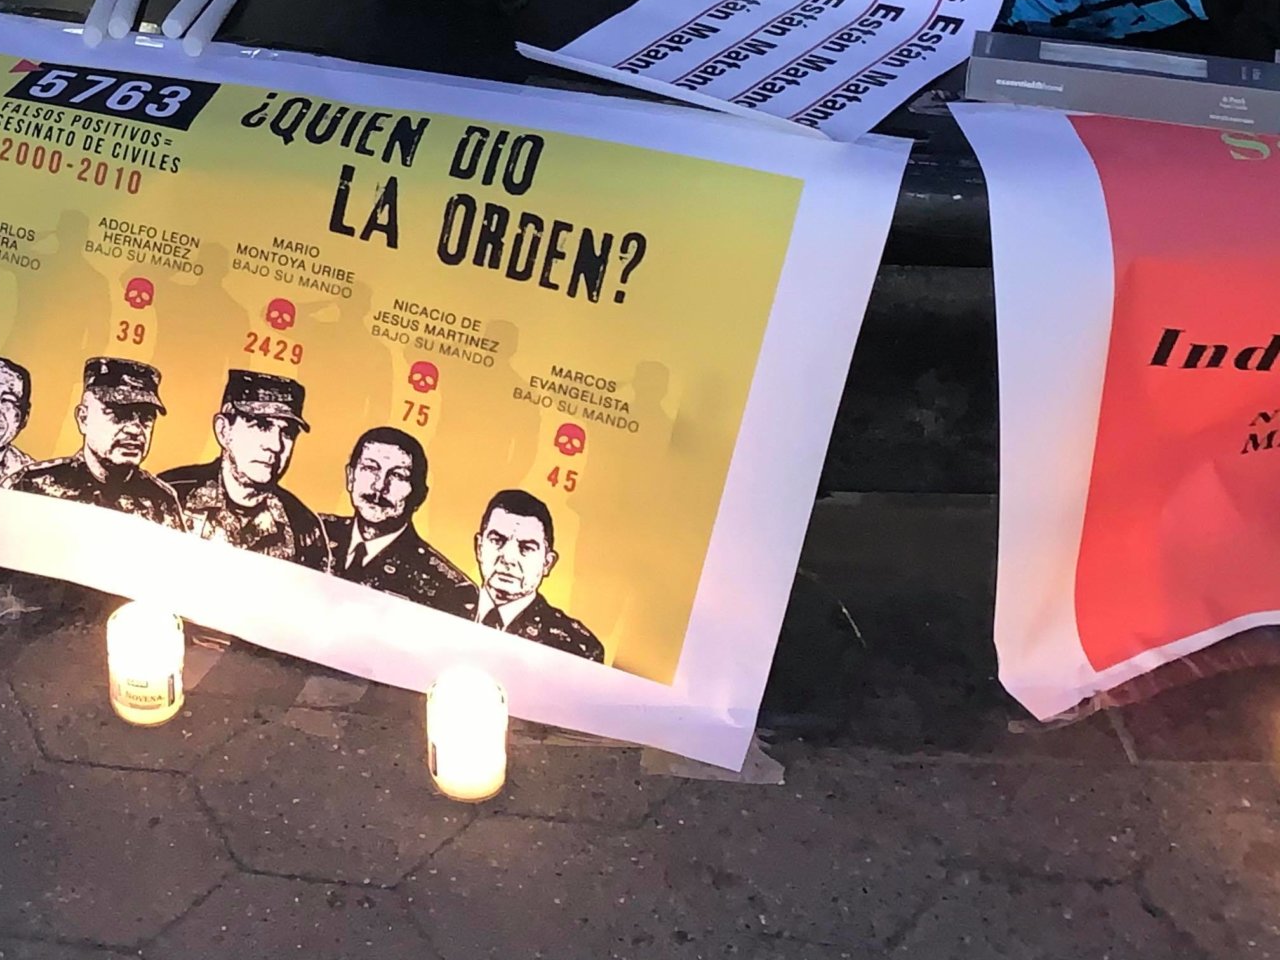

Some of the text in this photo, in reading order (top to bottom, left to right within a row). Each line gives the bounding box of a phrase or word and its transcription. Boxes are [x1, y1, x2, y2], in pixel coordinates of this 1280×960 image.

[822, 3, 905, 54] Están
[881, 14, 965, 68] Están
[1, 101, 65, 124] FALSOS
[28, 69, 192, 118] 5763
[82, 135, 105, 154] DE
[111, 141, 182, 174] CIVILES
[240, 92, 545, 196] ¿QUIEN DIO
[98, 217, 201, 249] ADOLFO LEON
[102, 231, 192, 261] HERNANDEZ
[272, 236, 320, 259] MARIO
[328, 164, 648, 304] LA ORDEN?
[84, 241, 204, 277] BAJO SU MANDO
[235, 242, 356, 285] MONTOYA URIBE
[231, 259, 353, 300] BAJO SU MANDO
[116, 320, 146, 346] 39
[372, 310, 500, 354] JESUS MARTINEZ
[392, 298, 482, 332] NICACIO DE
[243, 330, 305, 366] 2429
[370, 324, 496, 368] BAJO SU MANDO
[529, 375, 630, 415] EVANGELISTA
[550, 364, 618, 394] MARCOS
[401, 399, 430, 428] 75
[512, 387, 640, 435] BAJO SU MANDO
[546, 465, 578, 493] 45
